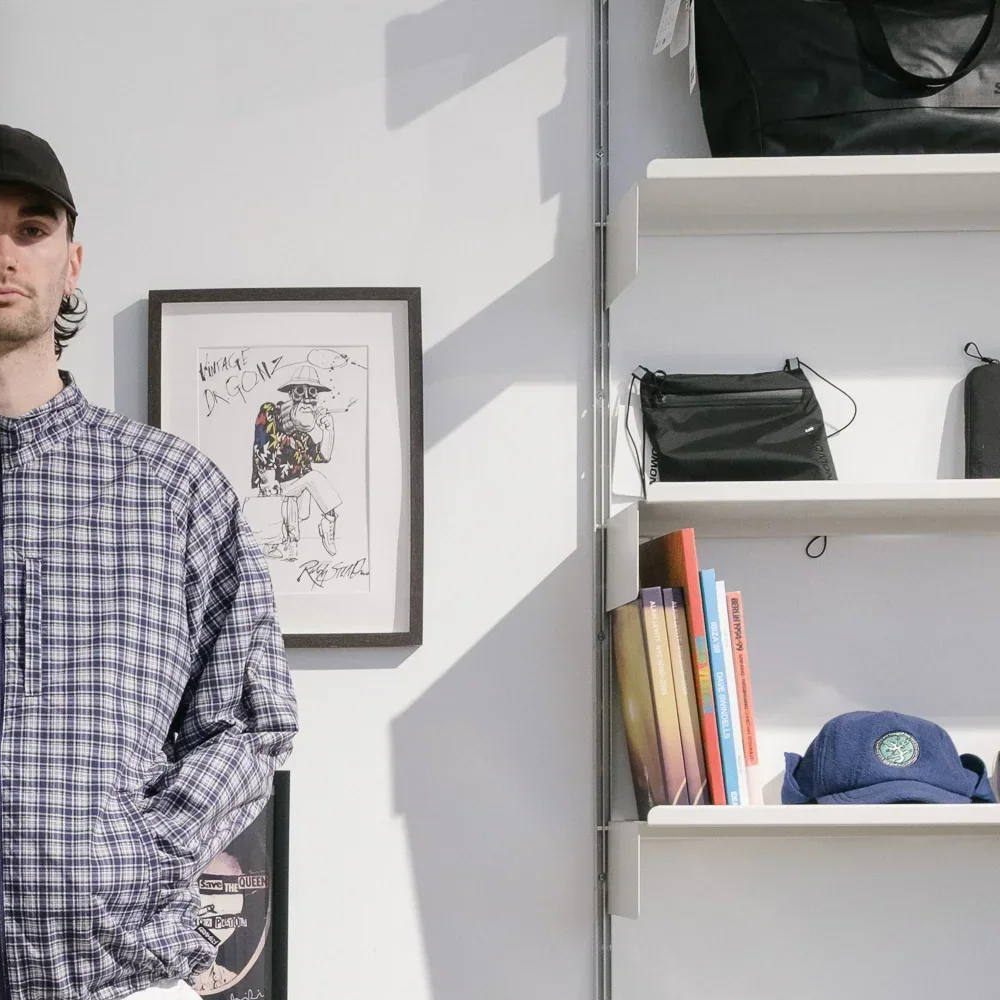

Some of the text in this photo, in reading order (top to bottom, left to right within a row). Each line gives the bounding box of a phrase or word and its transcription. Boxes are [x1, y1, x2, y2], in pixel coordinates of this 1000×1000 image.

[710, 622, 719, 641] IBIZA
[716, 672, 725, 693] DAVE
[719, 694, 731, 739] SWINDELLS
[224, 883, 239, 893] THE
[239, 876, 268, 888] QUEEN
